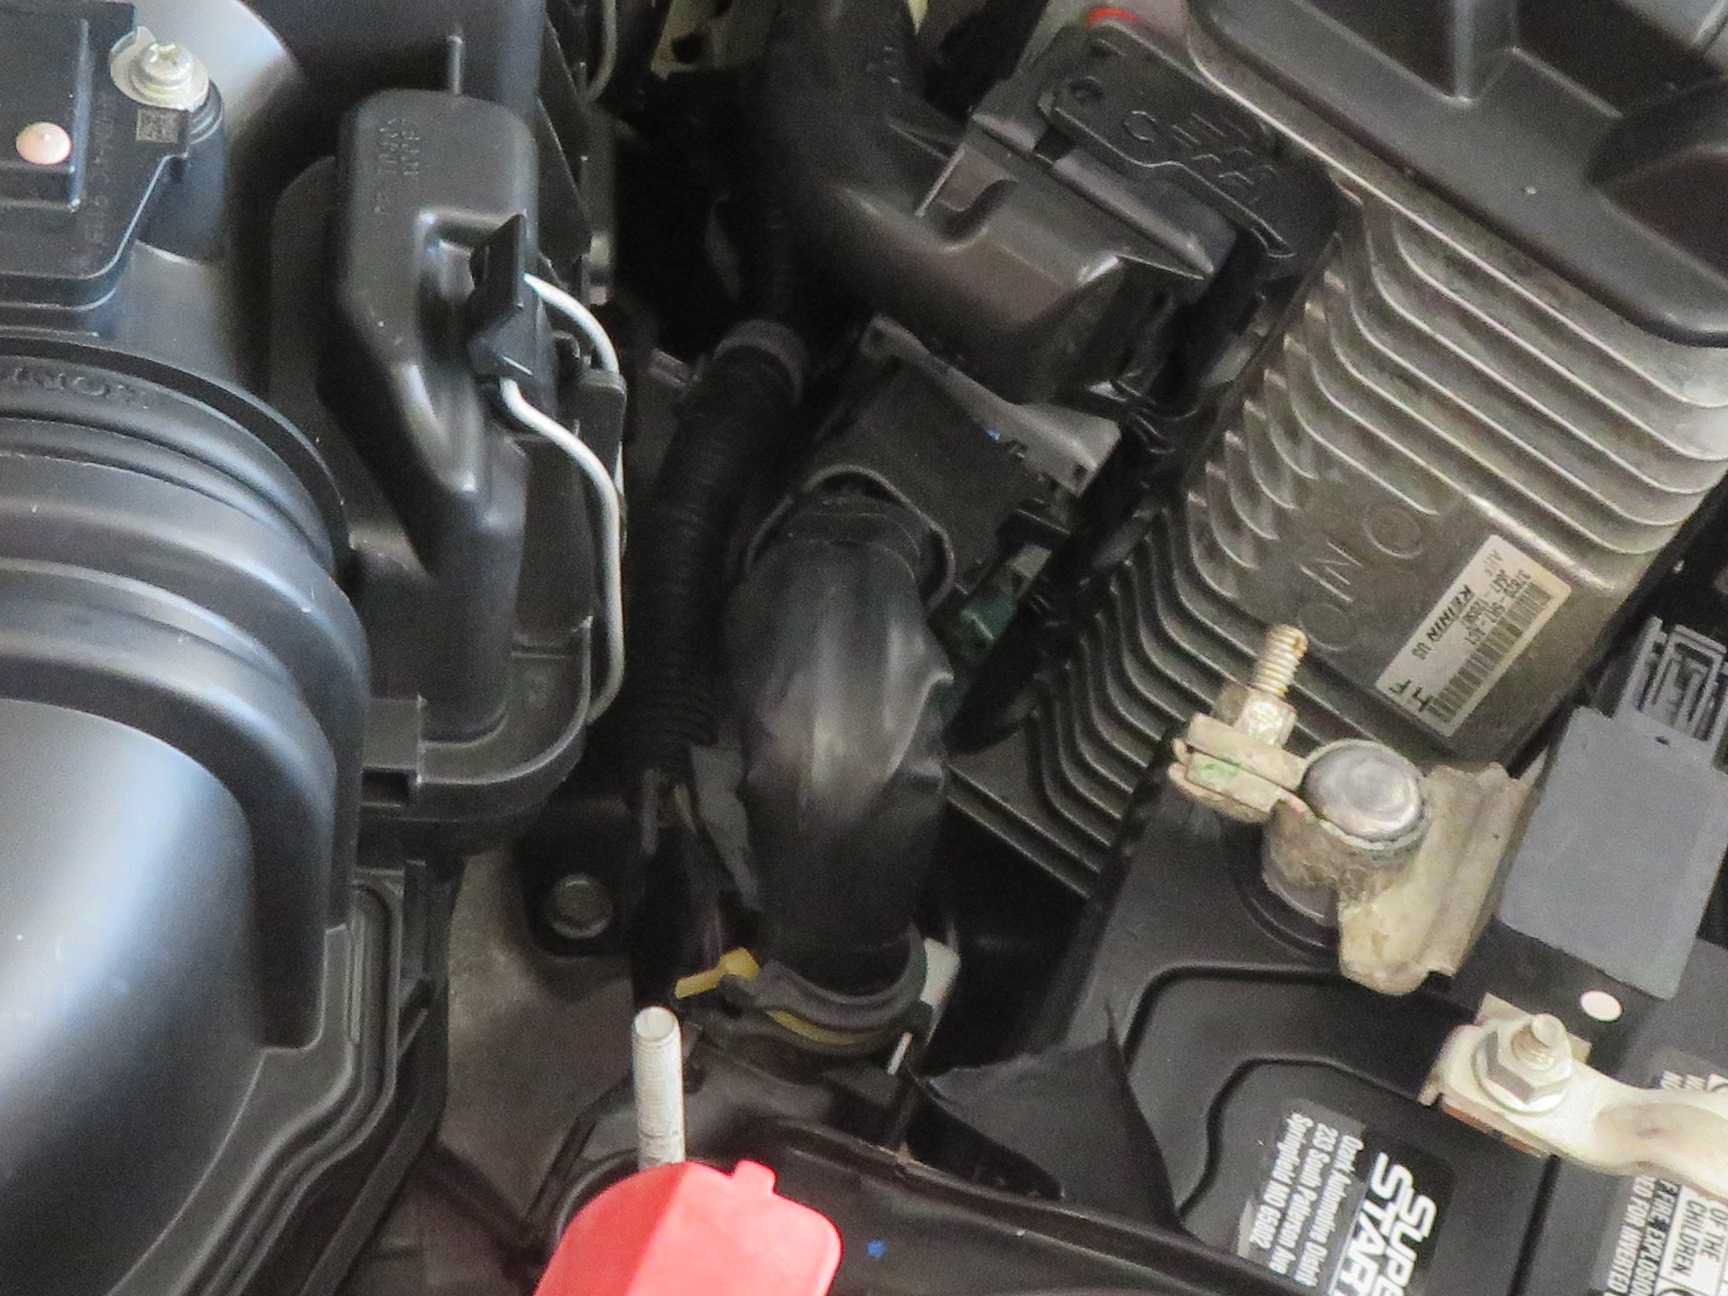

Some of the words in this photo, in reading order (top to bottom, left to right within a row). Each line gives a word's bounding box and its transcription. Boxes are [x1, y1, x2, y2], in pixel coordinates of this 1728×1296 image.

[1266, 1108, 1315, 1186] Springfield
[1310, 1121, 1339, 1153] 233
[1332, 1133, 1365, 1175] Ozark
[1297, 1145, 1331, 1189] South
[1261, 1178, 1291, 1209] MO
[1307, 1168, 1353, 1247] Automotive
[1622, 1192, 1651, 1228] FOR
[1246, 1202, 1282, 1252] 65802
[1274, 1183, 1318, 1253] Patterson
[1292, 1239, 1328, 1288] Distri
[1604, 1221, 1643, 1296] INVERTED
[1698, 1228, 1726, 1264] THE
